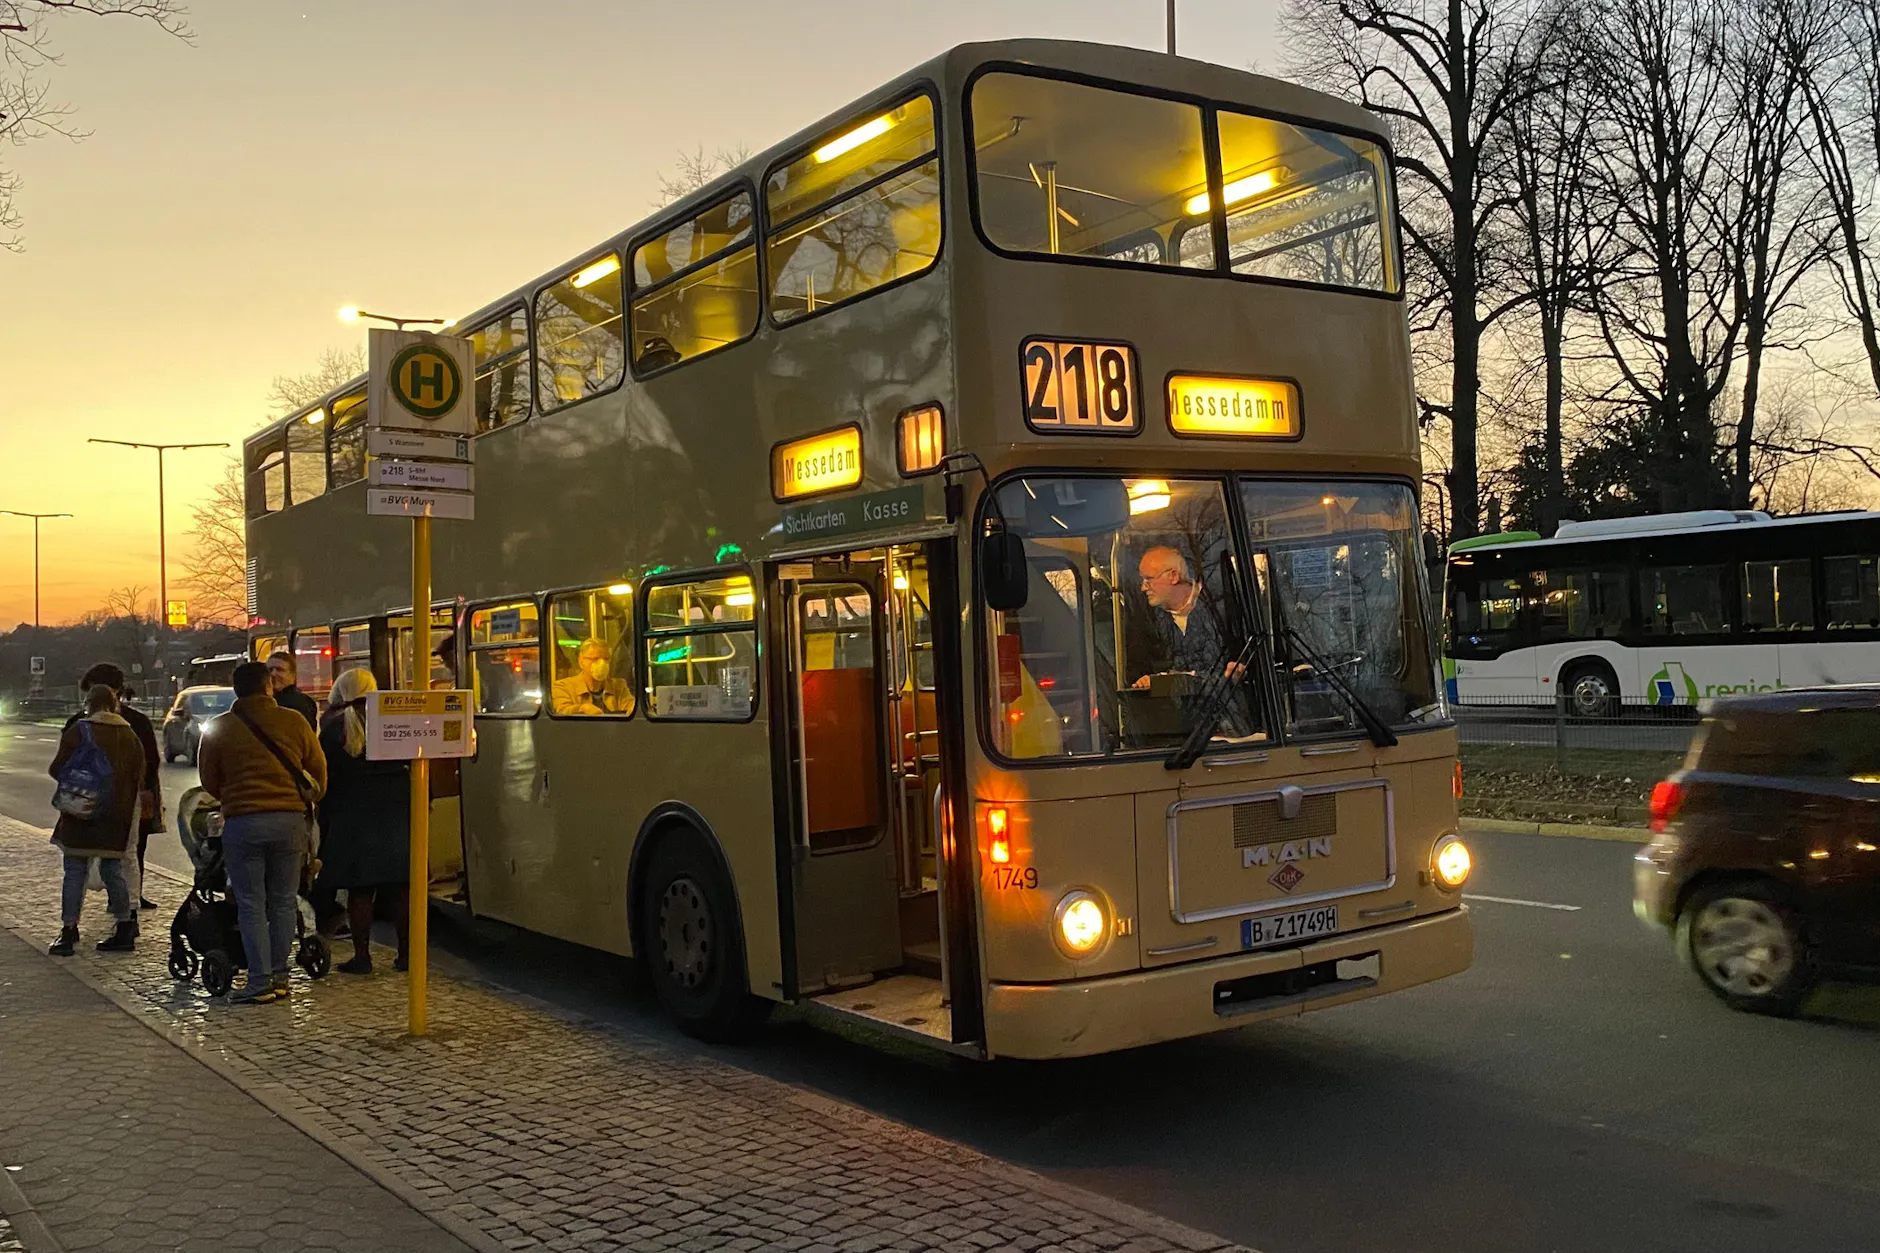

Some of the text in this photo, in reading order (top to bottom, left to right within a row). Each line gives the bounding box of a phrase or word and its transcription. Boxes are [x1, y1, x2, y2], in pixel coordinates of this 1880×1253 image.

[410, 360, 443, 401] H
[1025, 345, 1129, 422] 218
[388, 466, 404, 476] 218
[785, 448, 855, 485] Messedam
[388, 496, 435, 506] BVG Muva
[786, 500, 908, 534] Sichtkarten Kasse
[384, 696, 402, 704] BVG
[993, 867, 1038, 890] 1749
[1253, 922, 1263, 943] B
